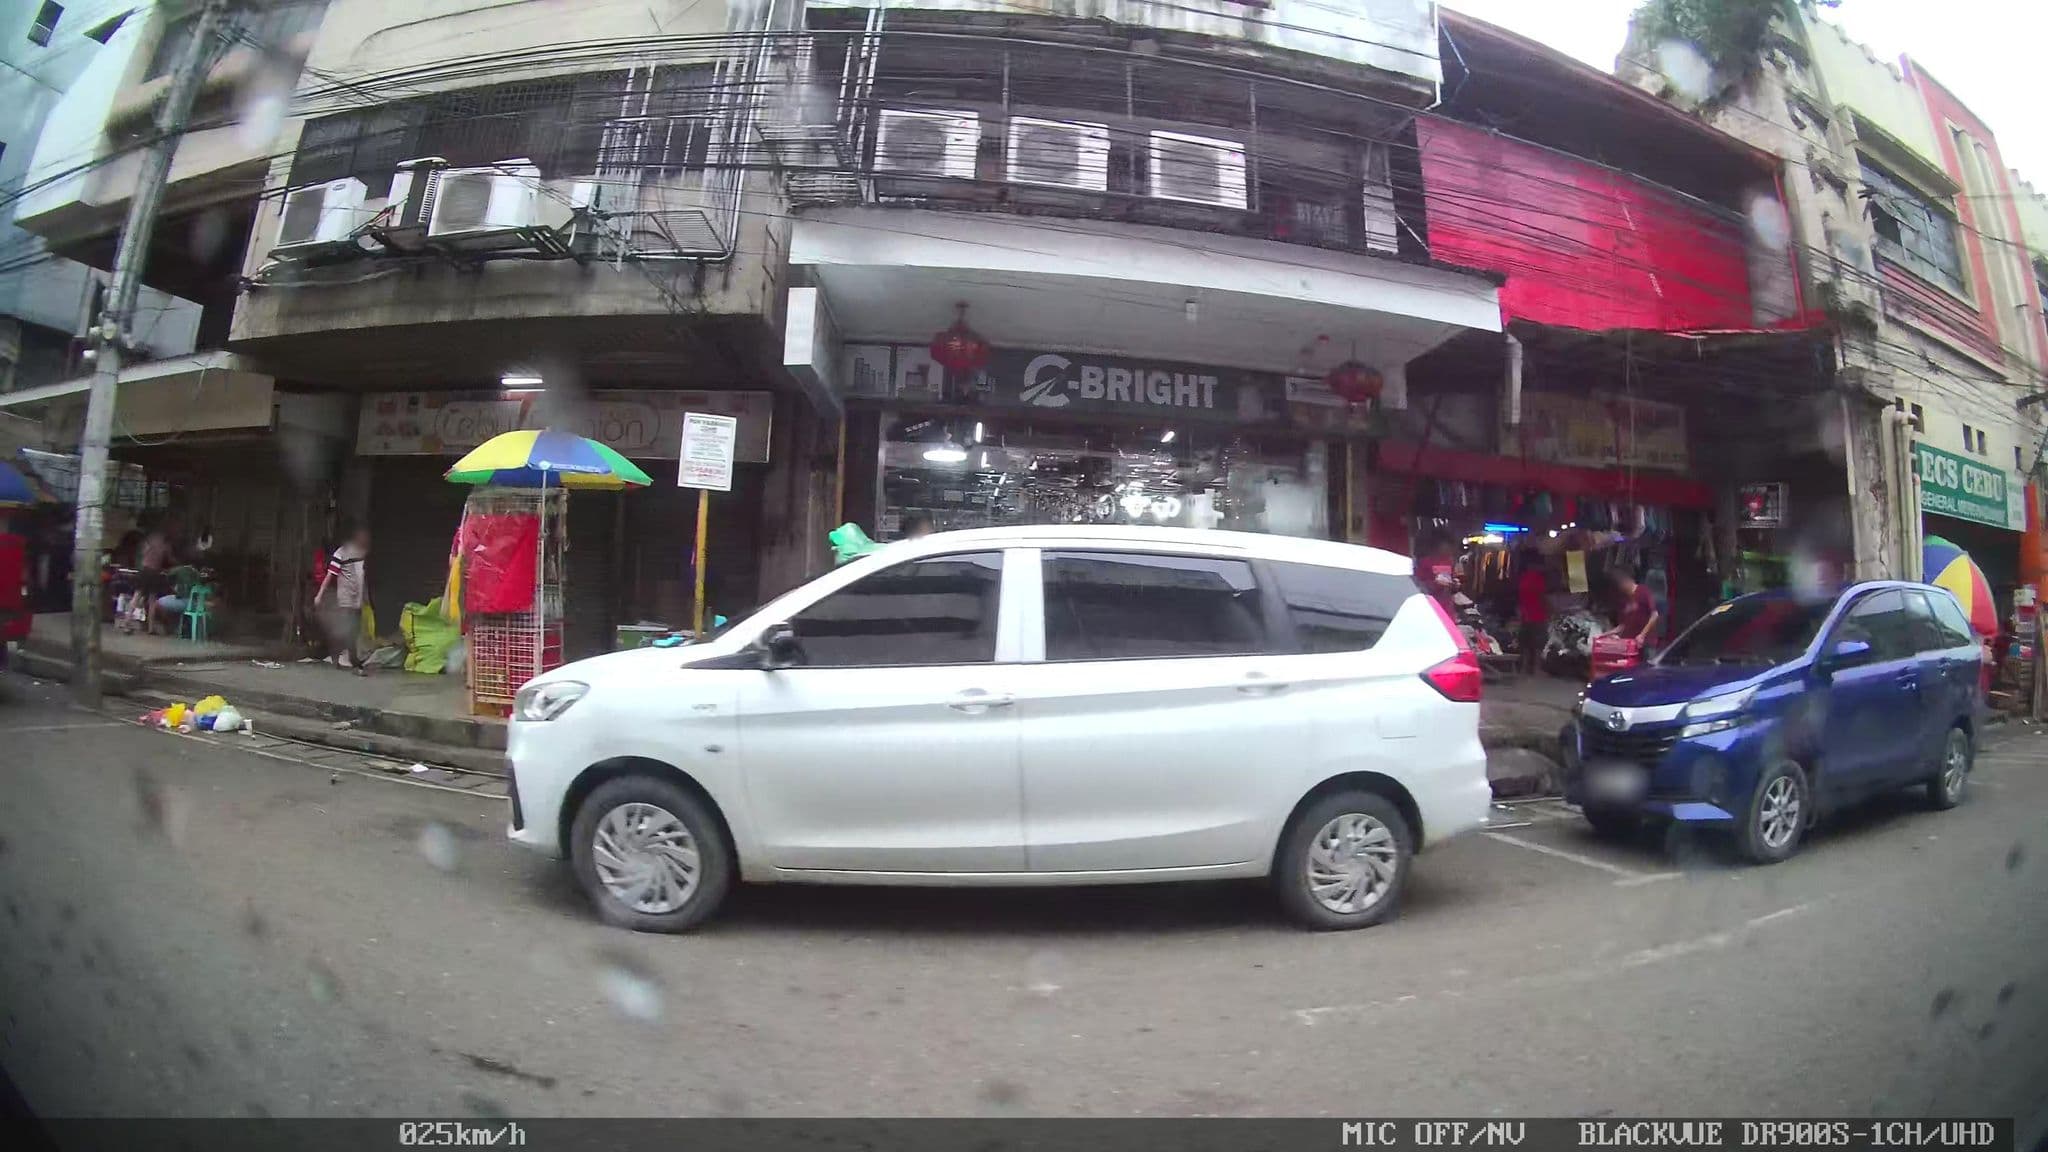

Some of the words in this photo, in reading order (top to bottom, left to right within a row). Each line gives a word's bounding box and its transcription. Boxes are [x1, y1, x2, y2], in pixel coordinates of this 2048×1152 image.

[1020, 354, 1218, 408] C-BRIGHT
[1920, 450, 1958, 490] ECS
[1962, 464, 2004, 502] CEBU
